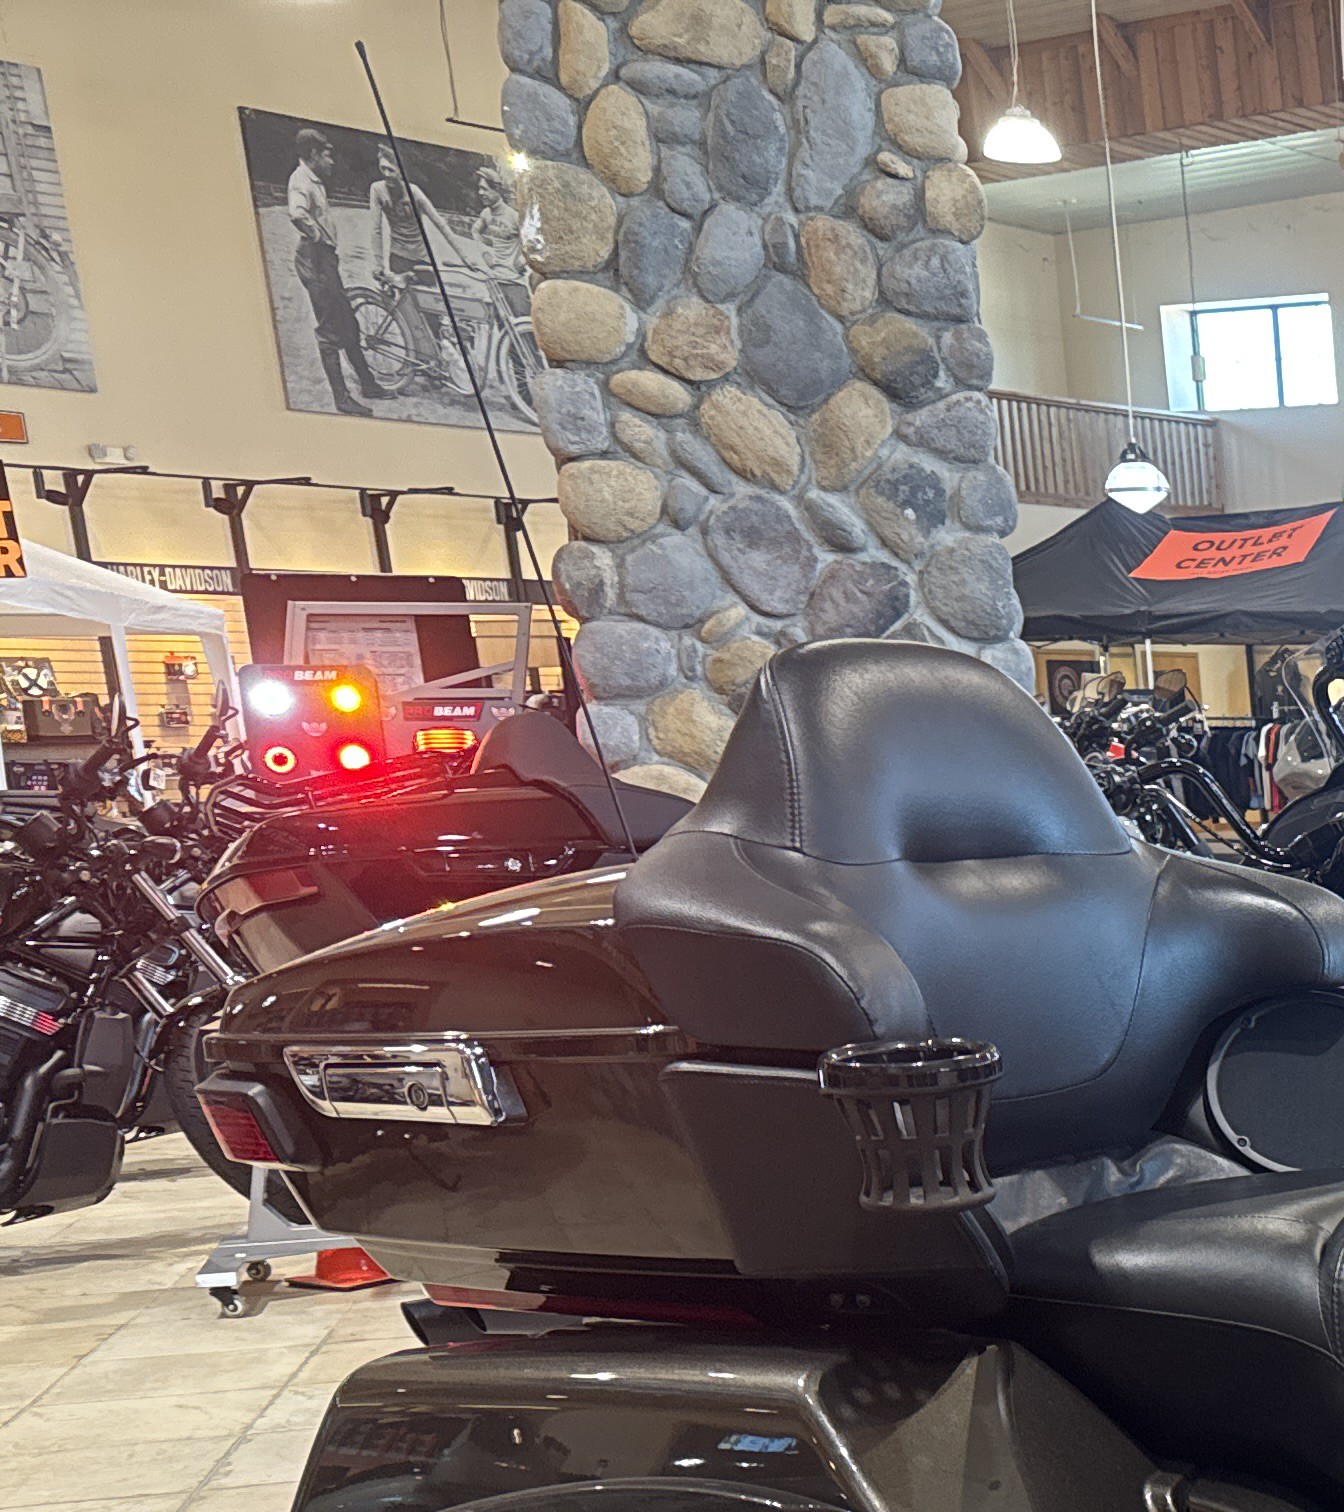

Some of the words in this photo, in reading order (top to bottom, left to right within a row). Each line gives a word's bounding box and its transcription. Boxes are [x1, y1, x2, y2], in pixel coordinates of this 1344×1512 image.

[1191, 524, 1306, 552] OUTLET
[1175, 545, 1289, 571] CENTER
[405, 705, 477, 718] PROBEAM
